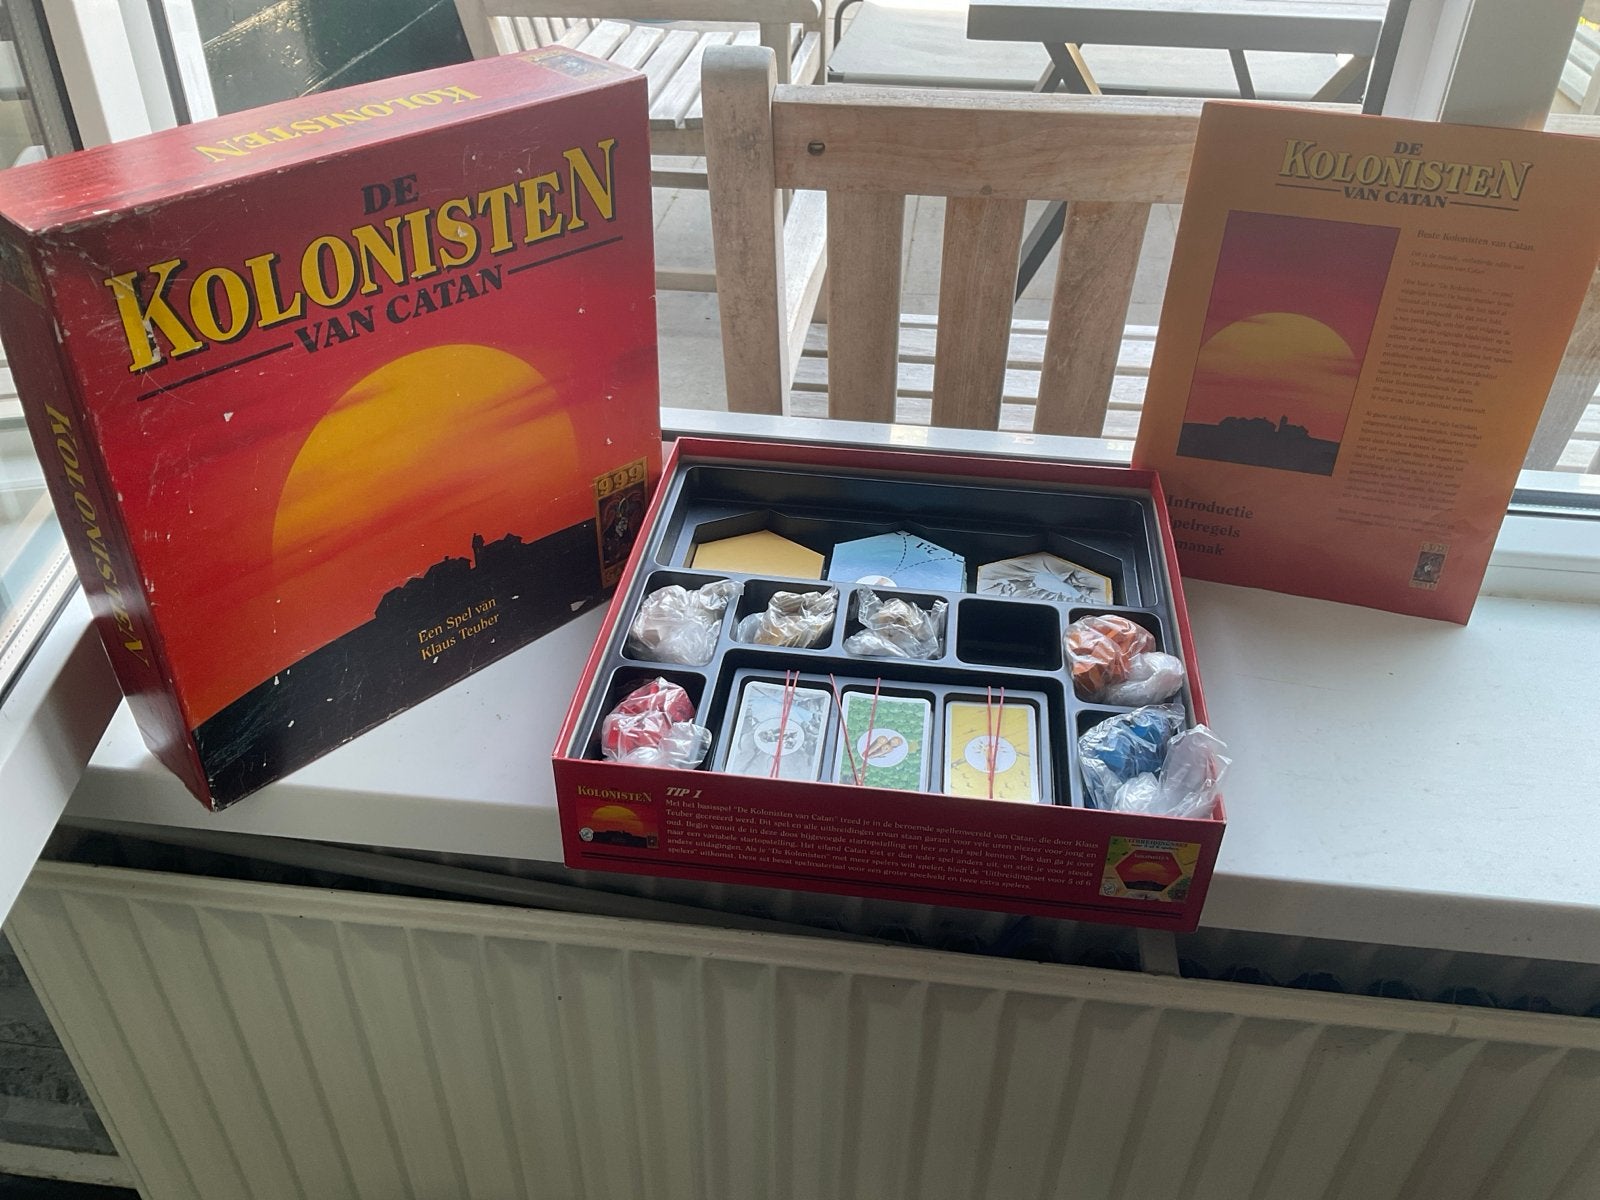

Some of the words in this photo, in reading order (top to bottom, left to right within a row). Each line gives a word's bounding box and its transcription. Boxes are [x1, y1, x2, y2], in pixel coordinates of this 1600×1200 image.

[195, 86, 482, 163] KOLONISTEN
[1393, 141, 1423, 156] DE
[1279, 138, 1534, 201] KOLONISTEN
[362, 173, 419, 216] DE
[1343, 185, 1379, 202] VAN
[1384, 189, 1448, 209] CATAN
[1442, 232, 1489, 246] Kolonisten
[1491, 240, 1506, 248] van
[104, 138, 618, 376] KOLONISTEN
[295, 305, 375, 354] VAN
[386, 264, 503, 325] CATAN
[598, 463, 644, 497] 999
[1167, 494, 1254, 519] Introductie
[45, 401, 150, 667] KOLONISTEN
[1170, 515, 1241, 538] pelregels
[916, 542, 939, 555] 2:1
[1176, 539, 1224, 556] manak
[418, 625, 443, 644] Een
[446, 606, 472, 630] Spel
[475, 598, 497, 615] van
[421, 635, 457, 660] Klaus
[458, 613, 500, 640] Teuber
[577, 784, 652, 802] KOLONISTEN
[664, 785, 690, 798] TIP
[692, 789, 702, 799] 1
